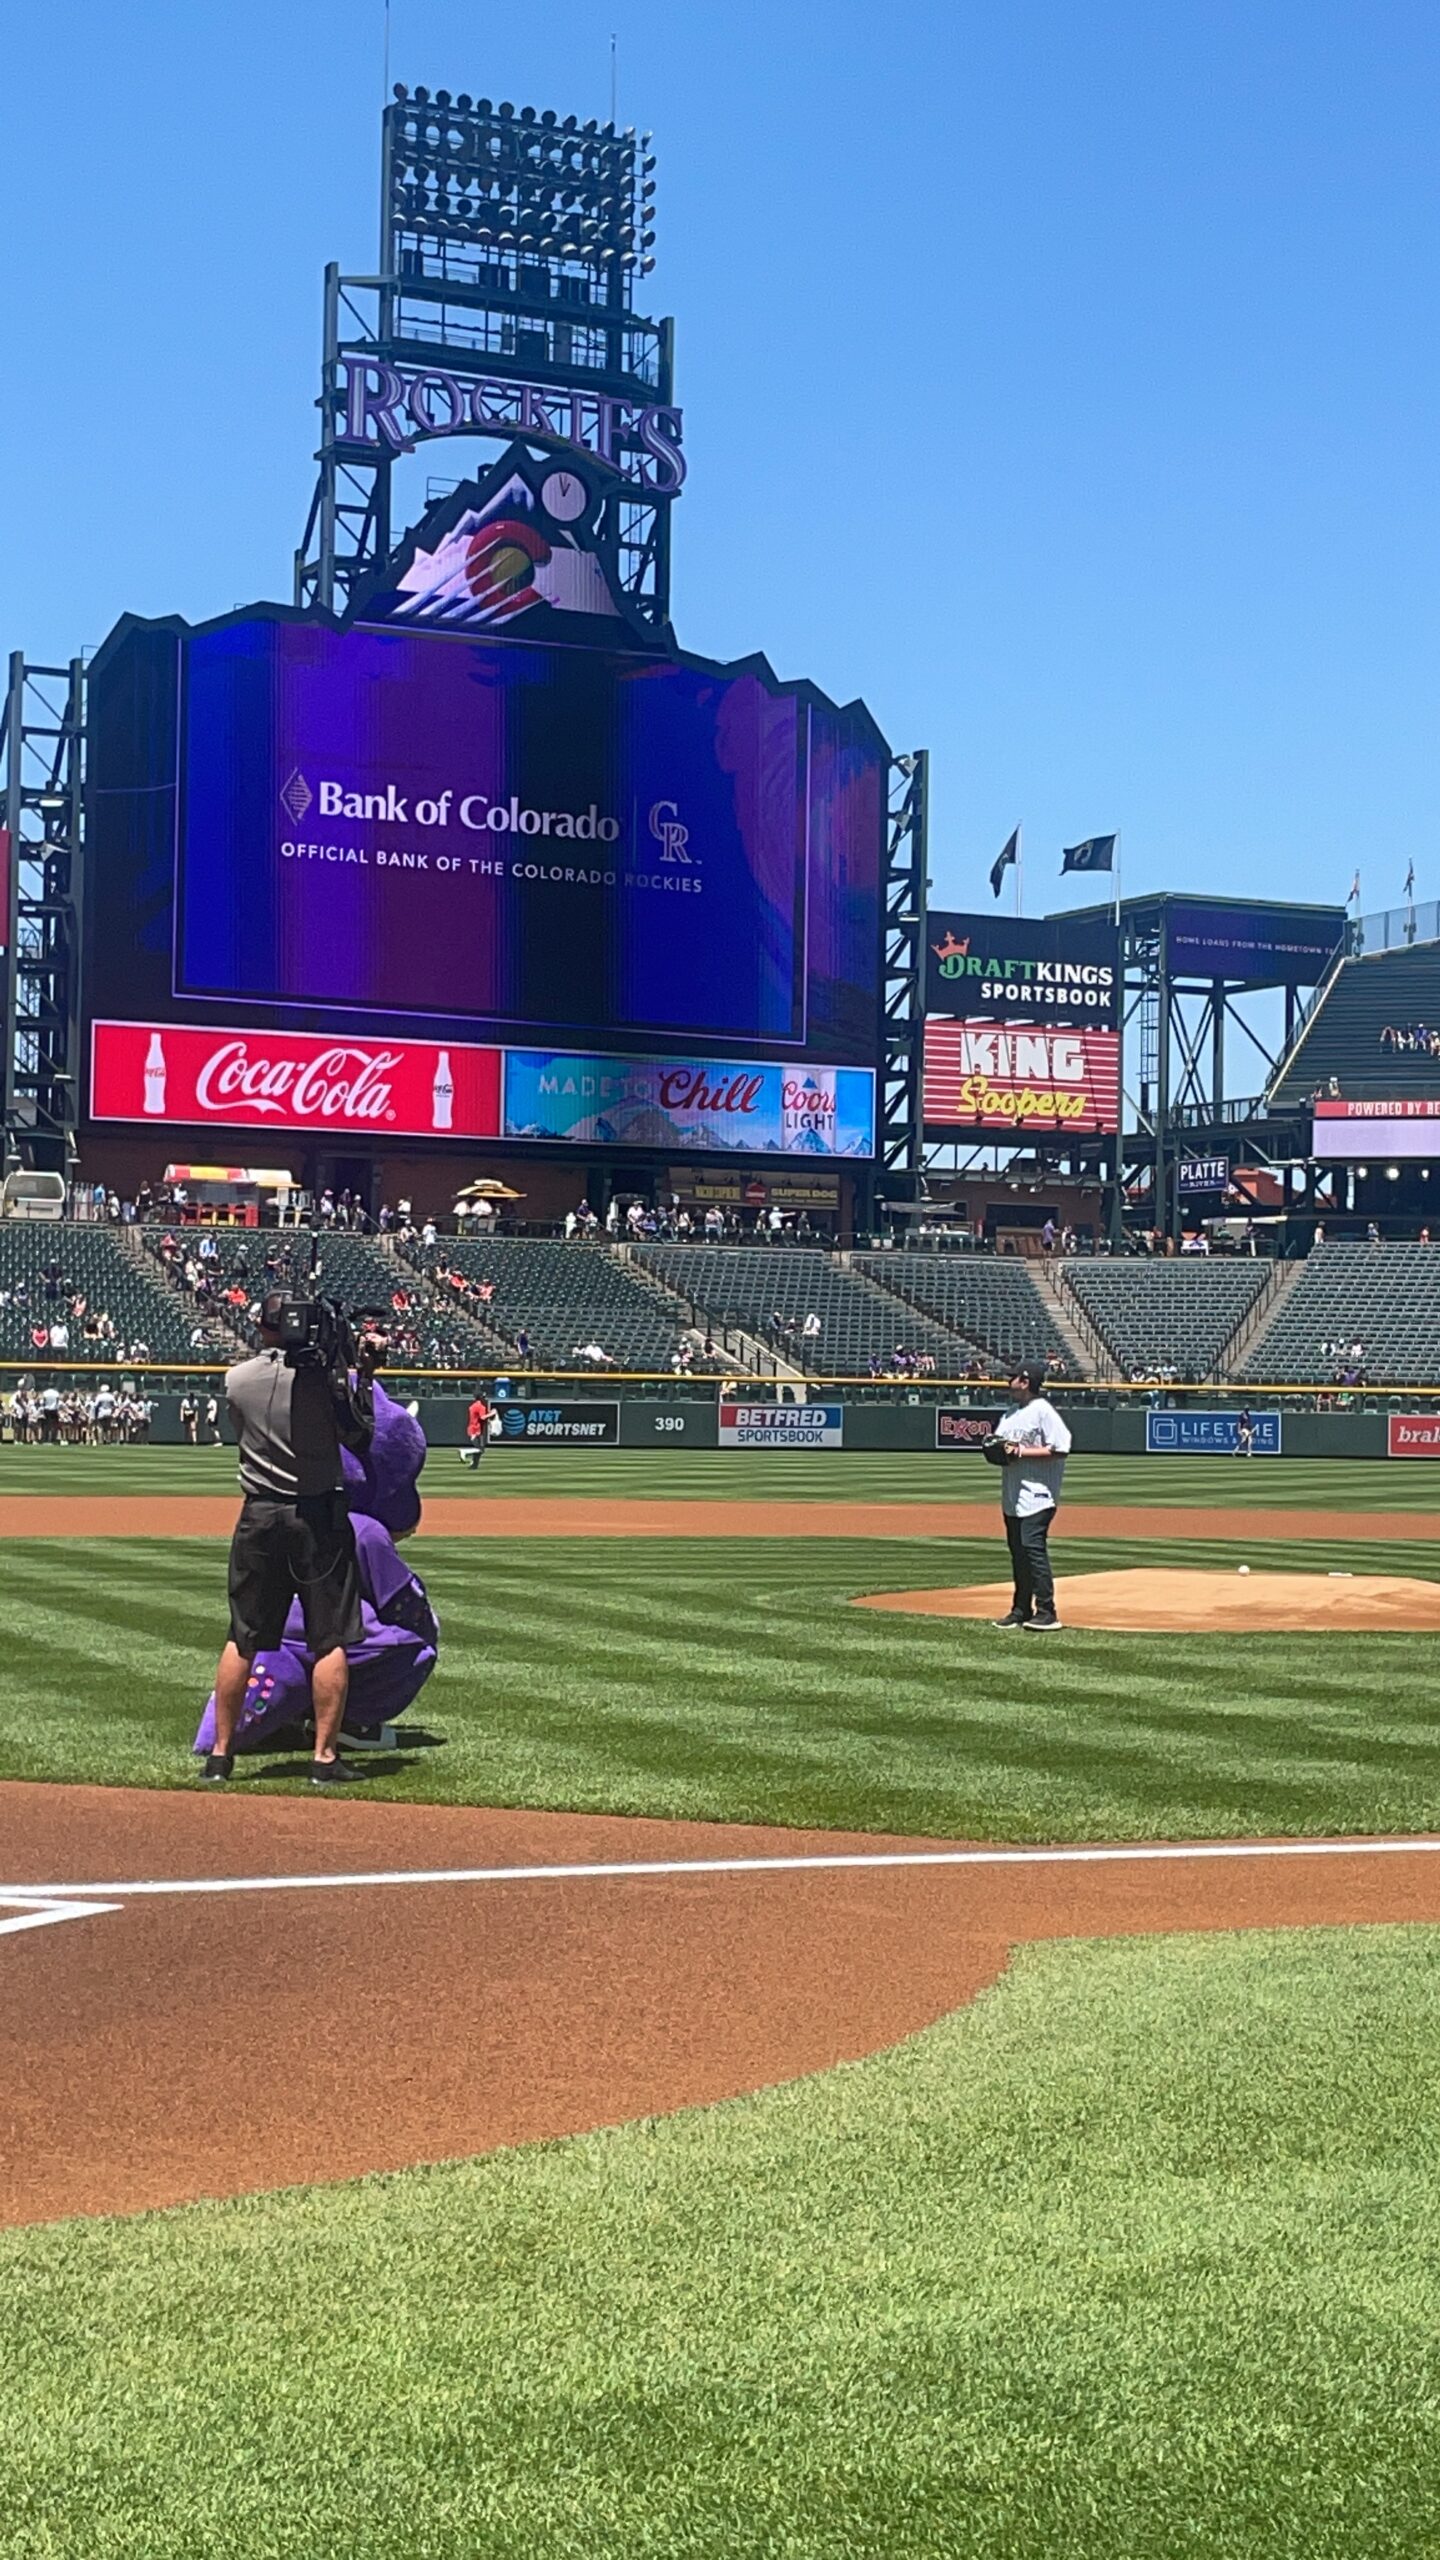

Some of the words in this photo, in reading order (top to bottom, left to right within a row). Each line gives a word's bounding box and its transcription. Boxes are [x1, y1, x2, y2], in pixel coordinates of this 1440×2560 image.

[336, 357, 687, 492] ROCKIES
[319, 781, 406, 823] Bank
[415, 790, 452, 827] of
[460, 796, 620, 842] Colorado
[281, 842, 369, 864] OFFICIAL
[376, 850, 429, 870] BANK
[436, 856, 462, 872] OF
[469, 859, 504, 876] THE
[512, 863, 616, 886] COLORADO
[624, 872, 703, 893] ROCKIES
[1232, 940, 1255, 949] FROM
[1257, 942, 1272, 950] THE
[939, 954, 1113, 985] DRAFTKINGS
[981, 982, 1111, 1008] SPORTSBOOK
[960, 1032, 1085, 1082] KING
[196, 1041, 405, 1119] Coca-Cola
[538, 1074, 611, 1098] MADE
[619, 1078, 651, 1099] TO
[659, 1070, 763, 1113] Chill
[956, 1076, 1086, 1125] Soopers
[1347, 1101, 1402, 1116] POWERED
[1407, 1102, 1421, 1116] BY
[786, 1113, 833, 1131] LIGHT
[1180, 1161, 1225, 1181] PLATTE
[527, 1410, 562, 1423] AT&T
[654, 1416, 684, 1432] 390
[735, 1407, 828, 1427] BETFRED
[526, 1422, 606, 1437] SPORTSNET
[737, 1429, 824, 1443] SPORTSBOOK
[940, 1416, 992, 1441] Exxon
[1181, 1421, 1273, 1437] LIFETME
[1182, 1437, 1229, 1445] WINDOWS
